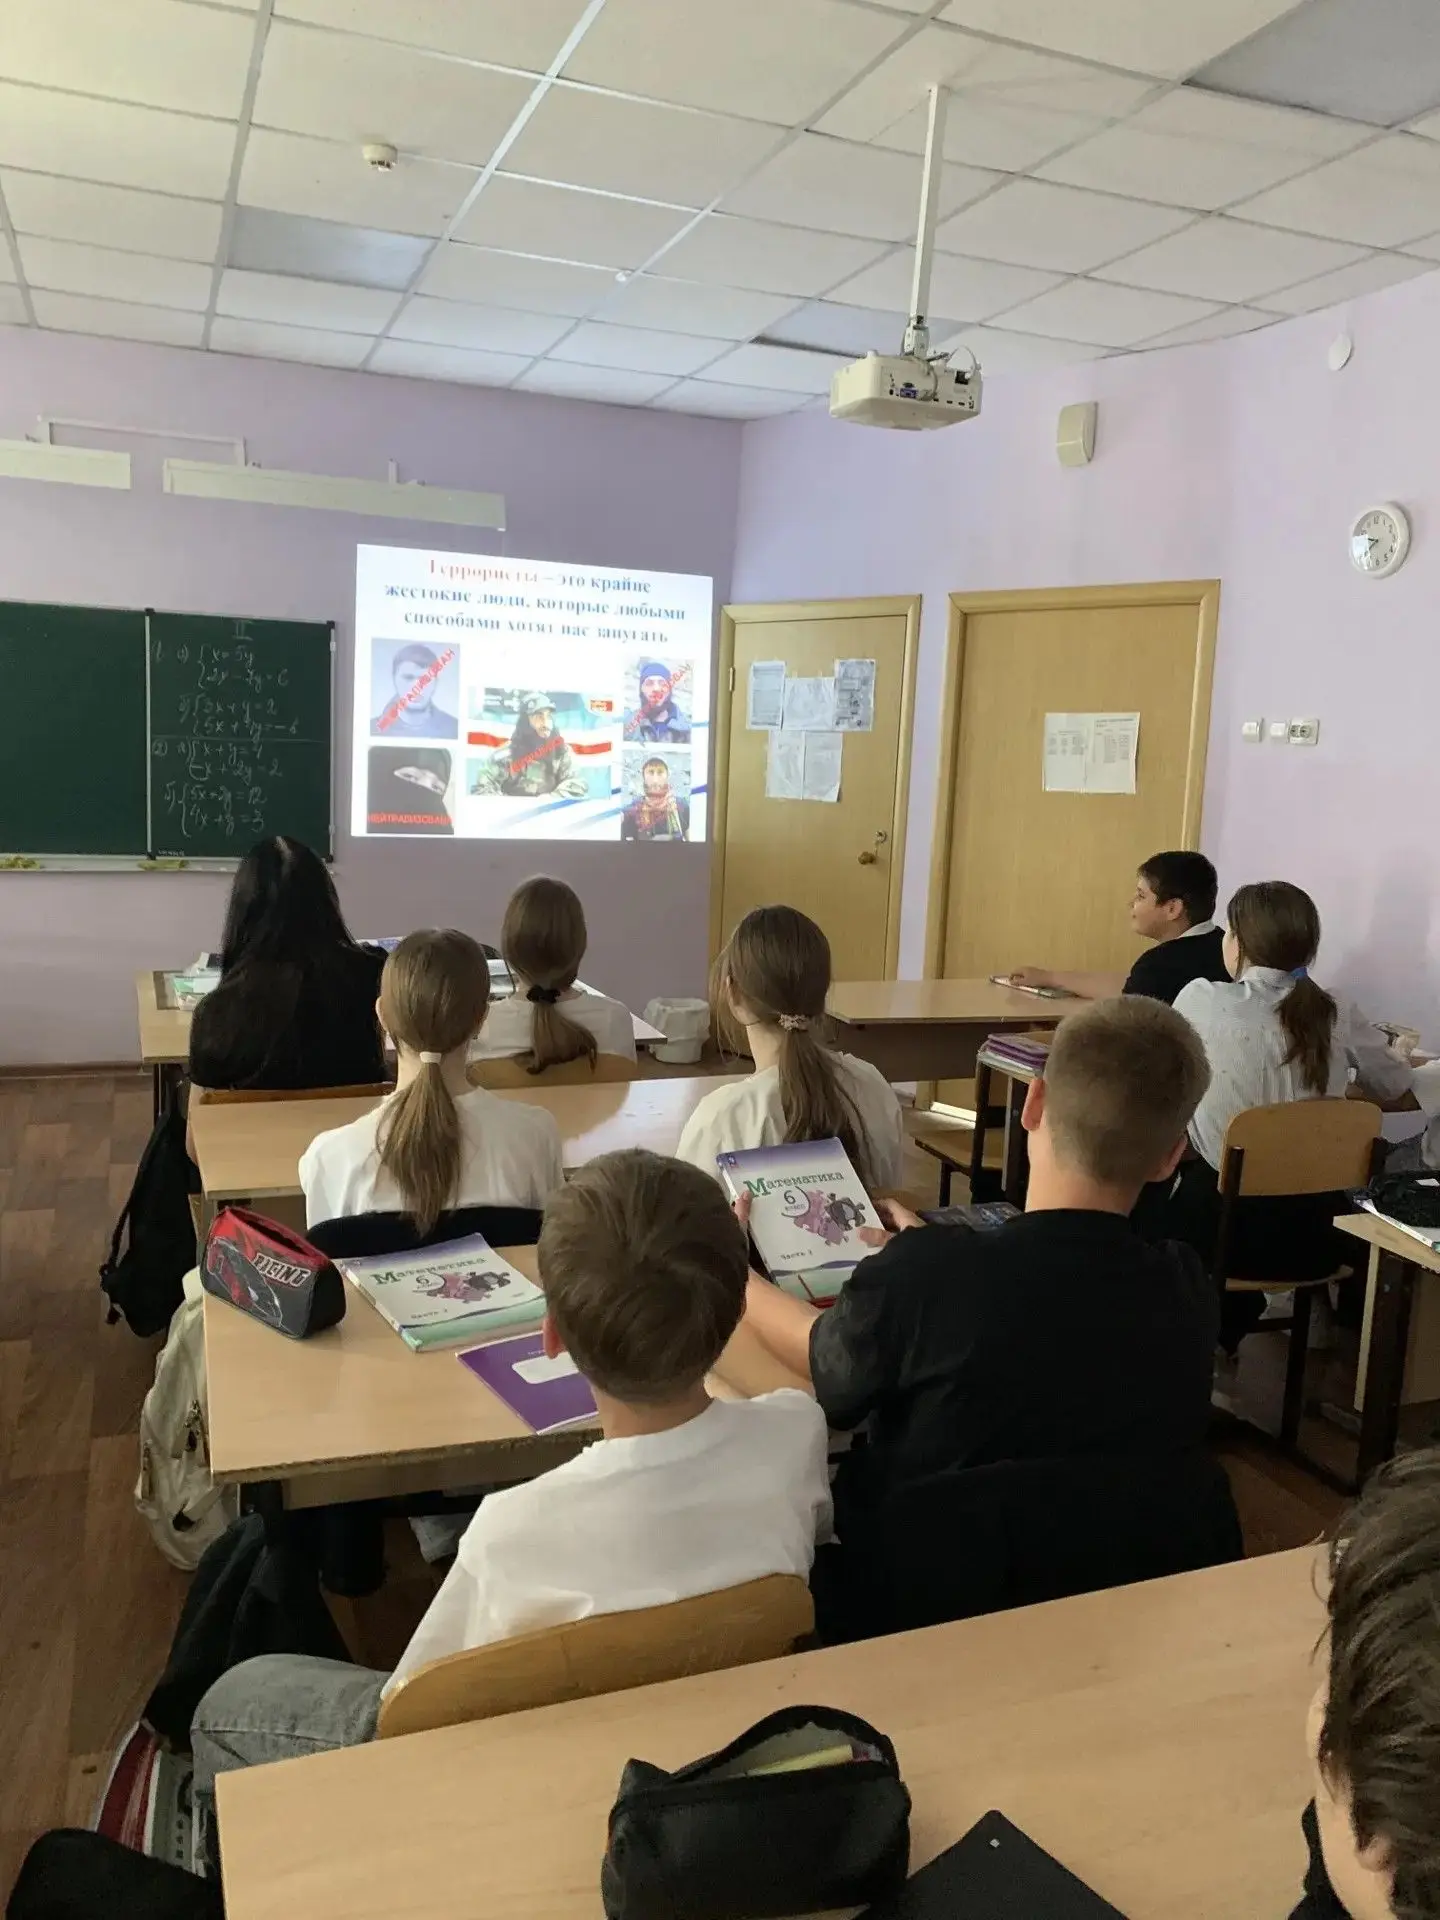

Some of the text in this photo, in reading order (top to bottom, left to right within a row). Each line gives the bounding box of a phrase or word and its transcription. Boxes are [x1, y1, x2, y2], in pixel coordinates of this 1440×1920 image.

[430, 559, 538, 582] Террористы
[557, 574, 586, 587] это
[591, 576, 652, 593] крайне
[385, 584, 472, 602] жестокие
[537, 598, 610, 615] которые
[613, 602, 685, 620] любыми
[404, 611, 500, 630] способами
[507, 620, 554, 633] хотят
[561, 624, 589, 636] нас
[376, 648, 456, 733] РАЛИЗОВАН
[743, 1170, 844, 1198] Математика
[783, 1189, 796, 1204] 6
[781, 1251, 806, 1261] Часть
[370, 1257, 488, 1286] Математика
[415, 1274, 430, 1286] 6
